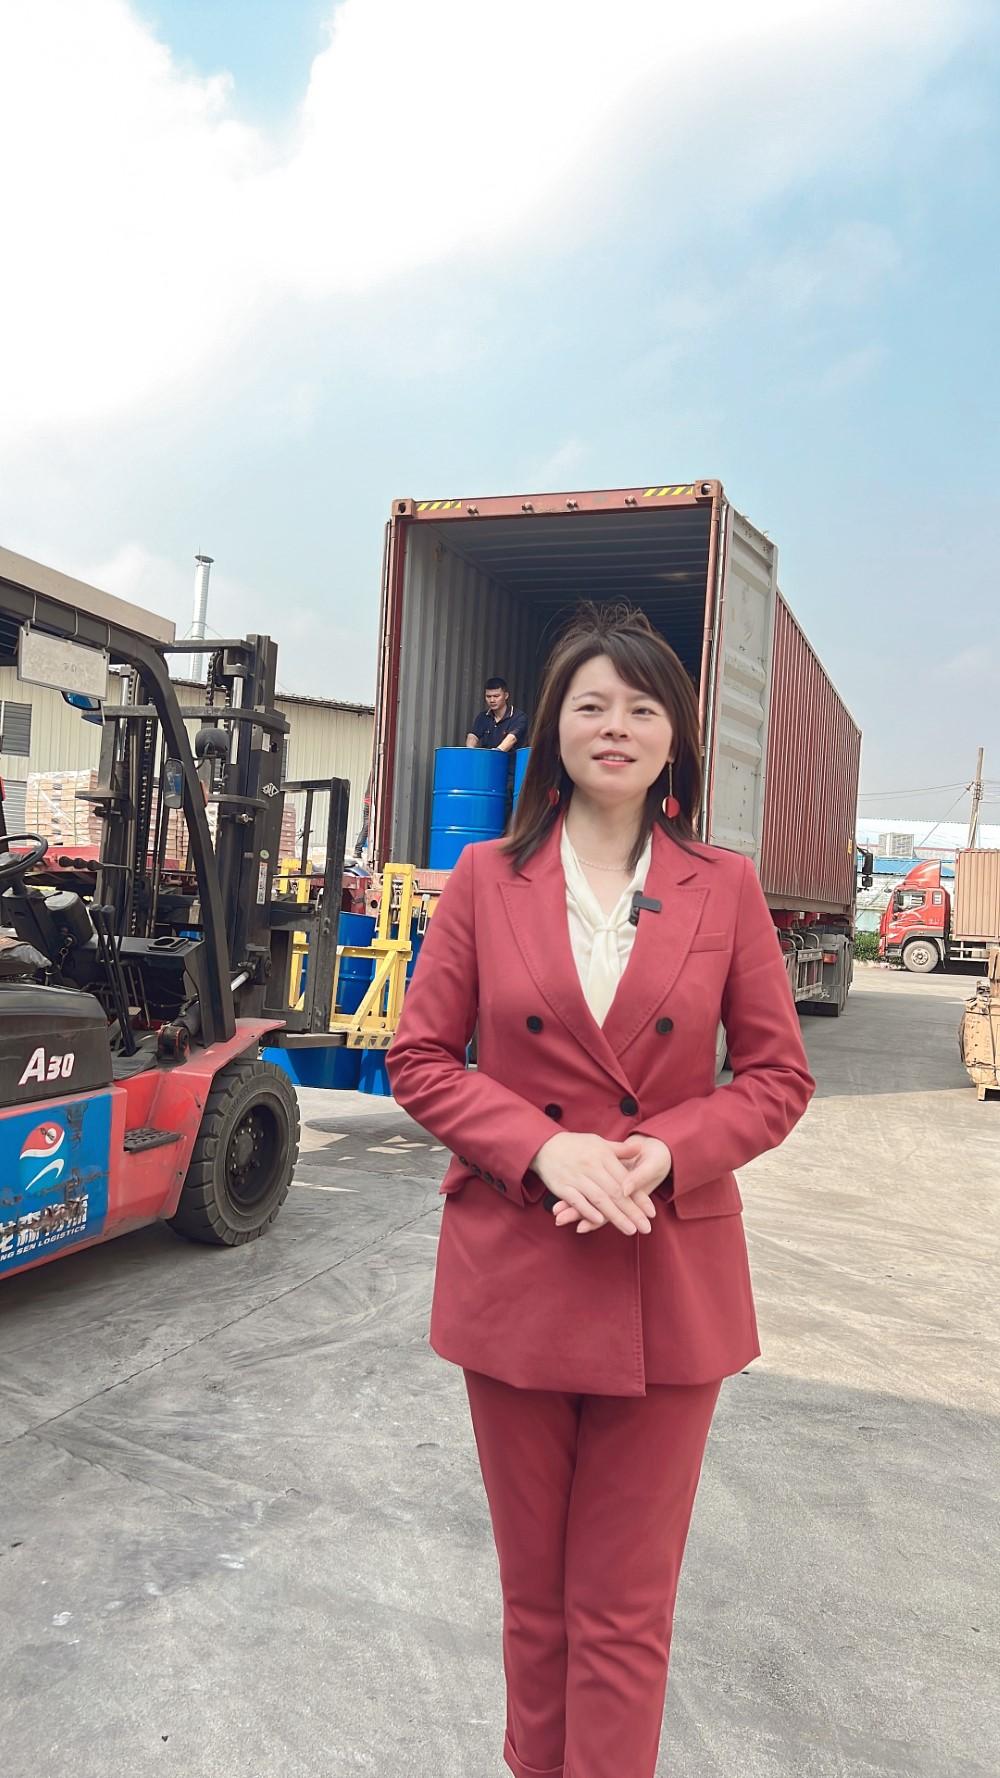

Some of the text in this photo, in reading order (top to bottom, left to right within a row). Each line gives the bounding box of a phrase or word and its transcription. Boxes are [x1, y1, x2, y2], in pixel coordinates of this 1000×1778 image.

[18, 1047, 75, 1085] A30
[16, 1242, 36, 1255] SEN
[38, 1225, 86, 1246] LOGISTICS
